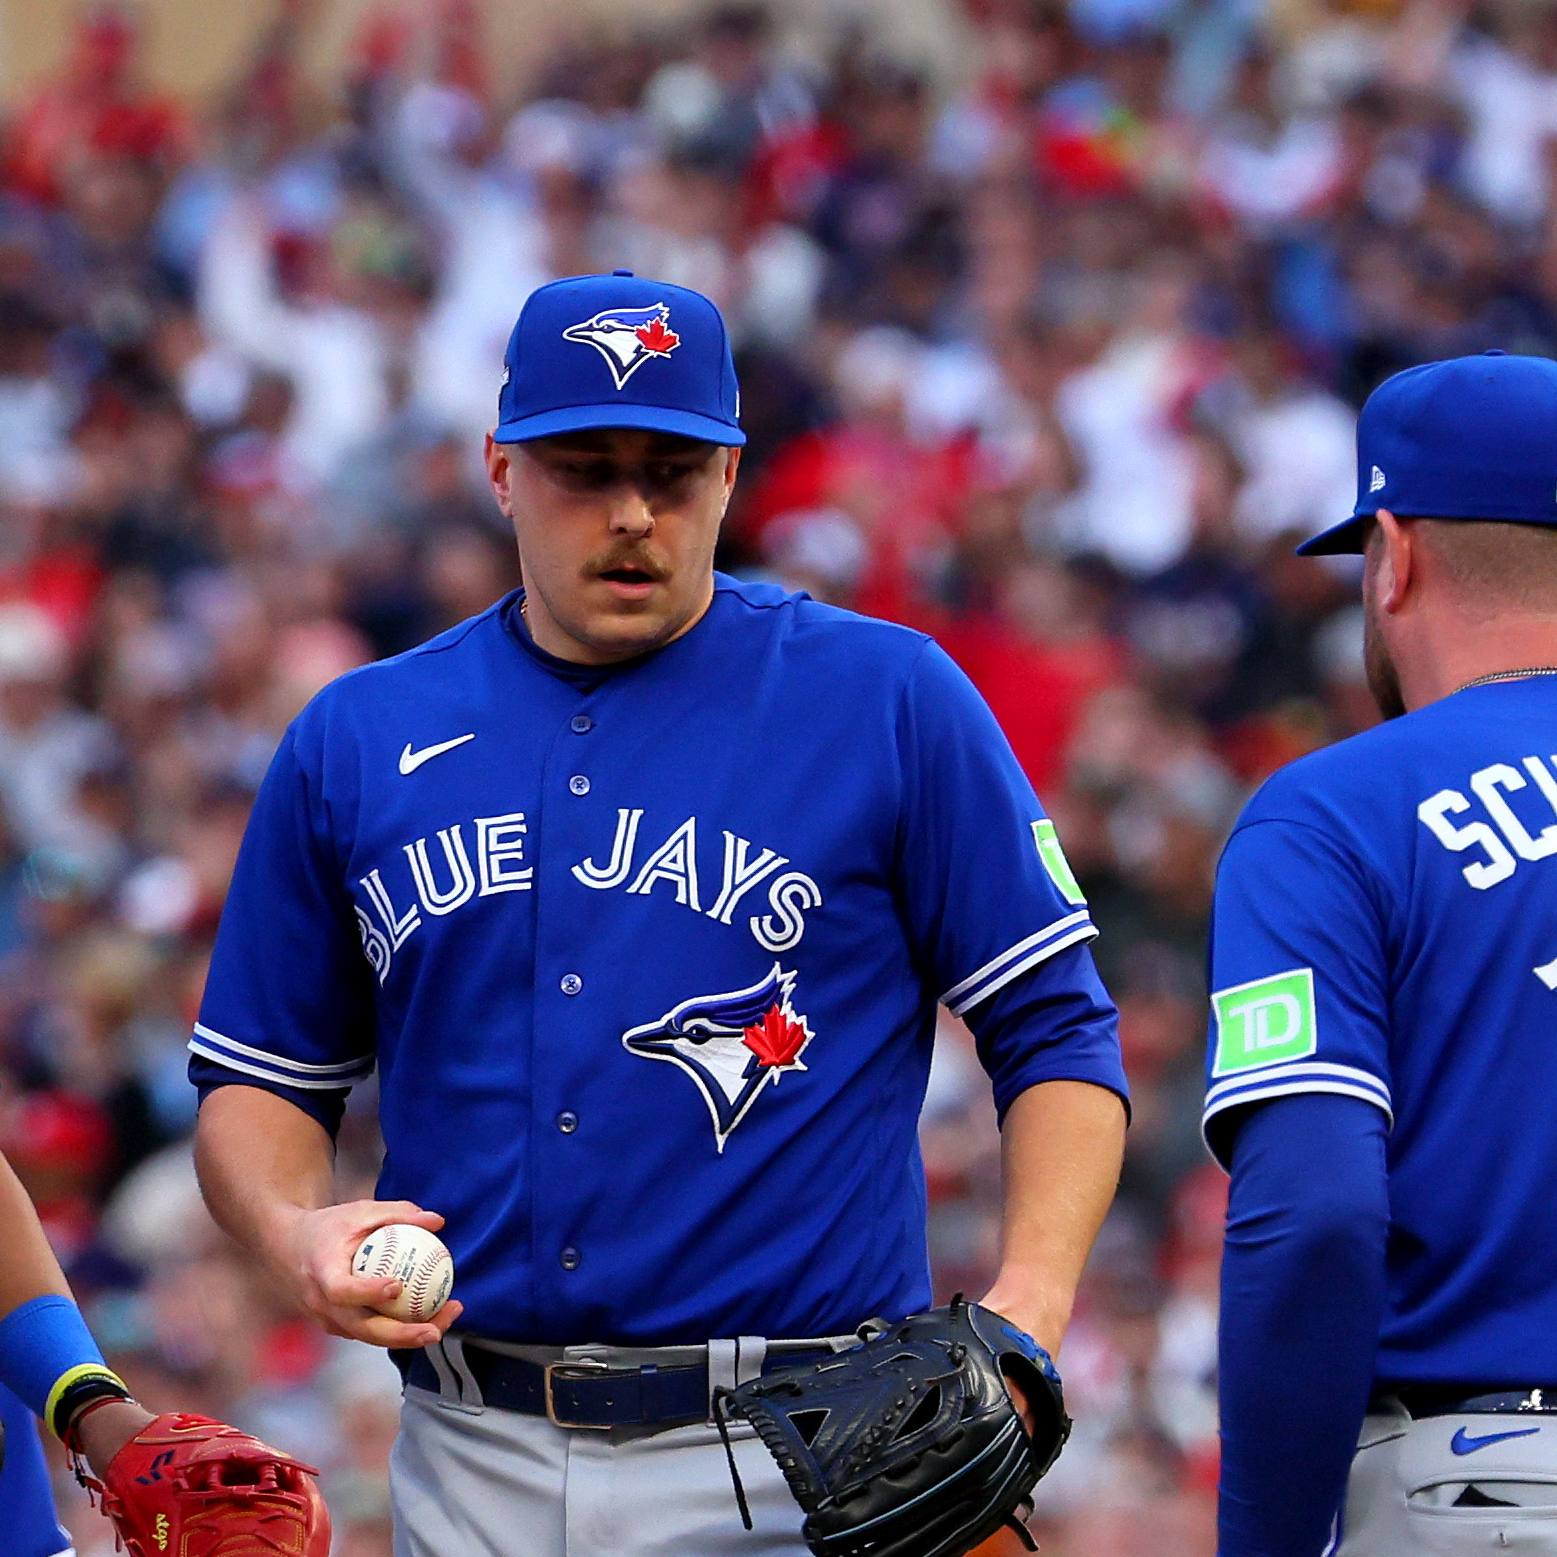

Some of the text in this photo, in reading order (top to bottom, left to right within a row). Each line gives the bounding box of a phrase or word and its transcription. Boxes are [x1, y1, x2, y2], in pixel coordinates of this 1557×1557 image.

[354, 806, 824, 988] BLUE JAYS
[1226, 989, 1304, 1053] TD
